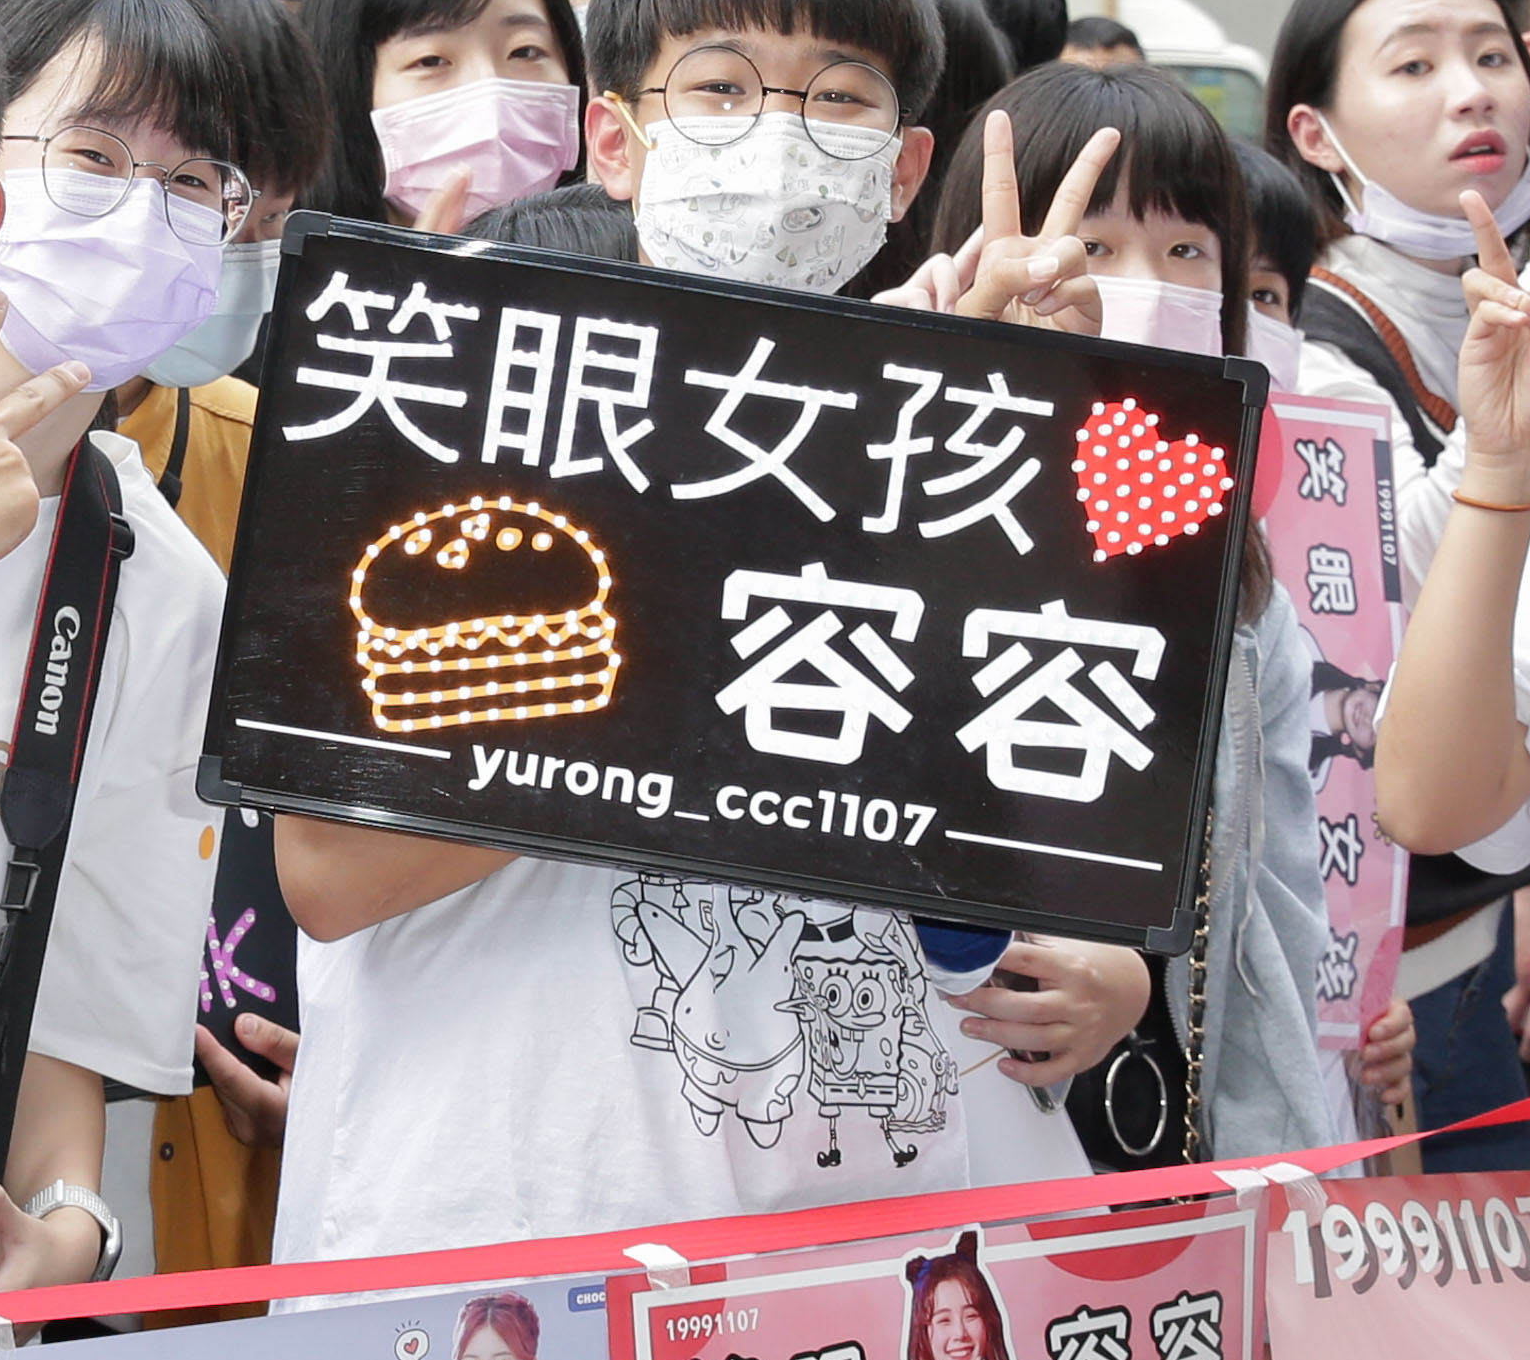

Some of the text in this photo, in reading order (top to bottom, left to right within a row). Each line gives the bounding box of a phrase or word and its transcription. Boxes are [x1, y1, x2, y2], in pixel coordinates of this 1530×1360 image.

[283, 270, 1054, 556] 笑眼女孩
[1379, 479, 1398, 567] 19991107
[34, 604, 81, 737] Canon
[715, 562, 1168, 803] 容容
[468, 745, 938, 848] yurong_ccc1107
[665, 1308, 760, 1342] 19991107
